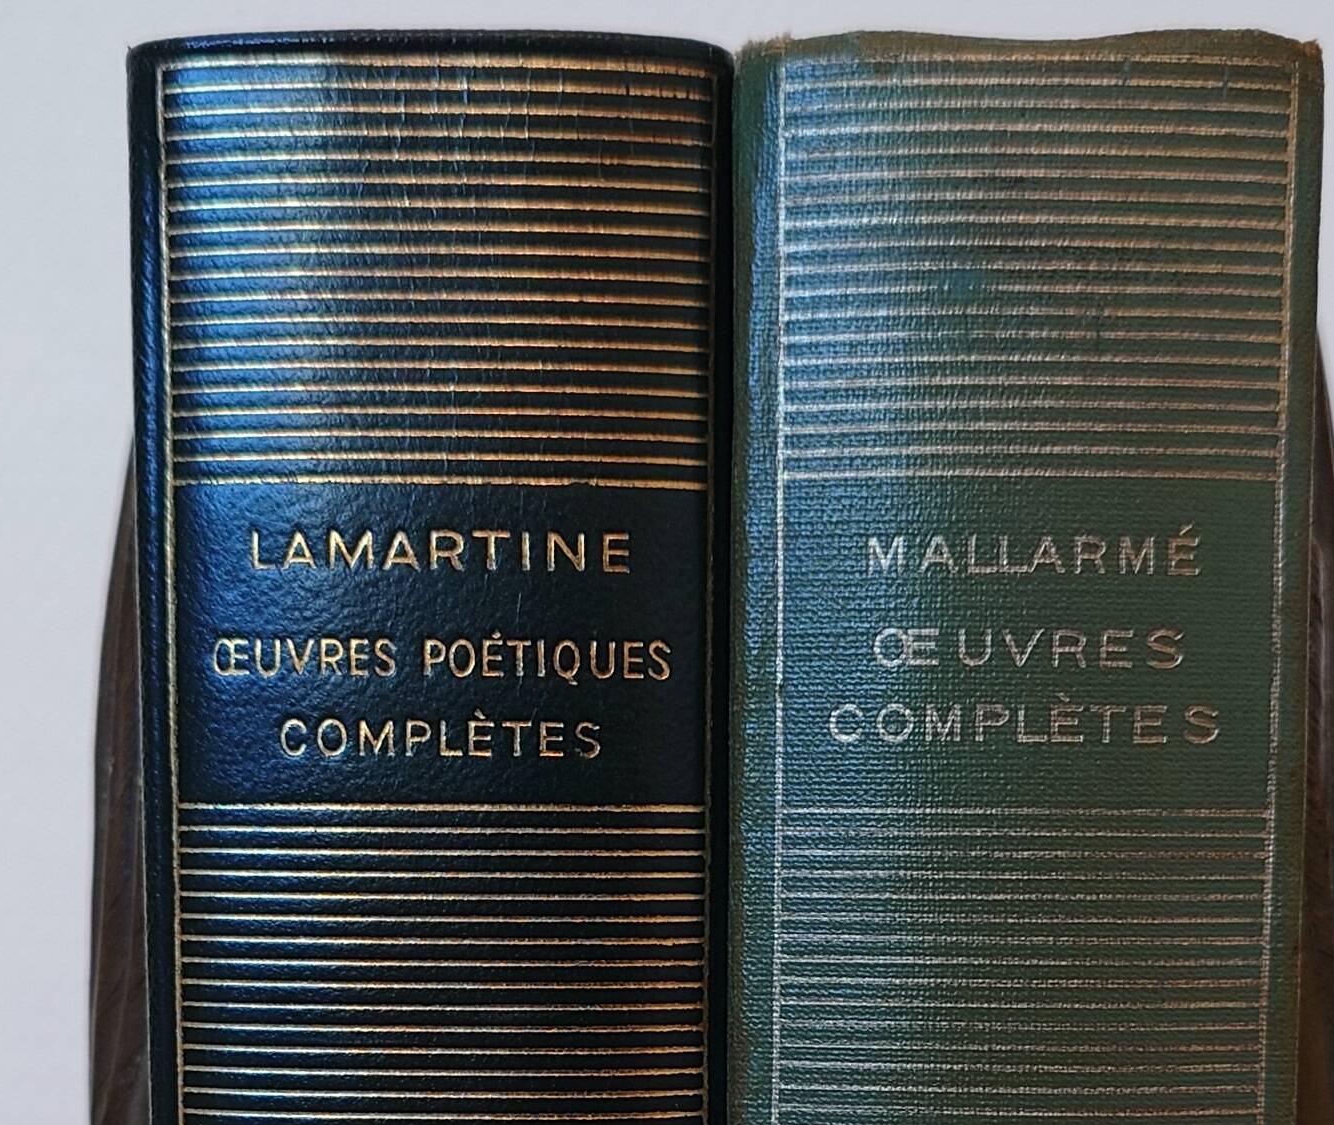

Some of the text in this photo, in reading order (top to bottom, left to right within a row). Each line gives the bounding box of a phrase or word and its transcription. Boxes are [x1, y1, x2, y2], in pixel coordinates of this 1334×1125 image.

[250, 528, 630, 574] LAMARTINE
[866, 524, 1201, 577] MALLARMÉ
[212, 630, 672, 687] ŒUVRES POÉTIQUES
[873, 627, 1185, 670] ŒUVRES
[279, 708, 602, 759] COMPLÈTES
[829, 693, 1220, 745] COMPLÈTES
